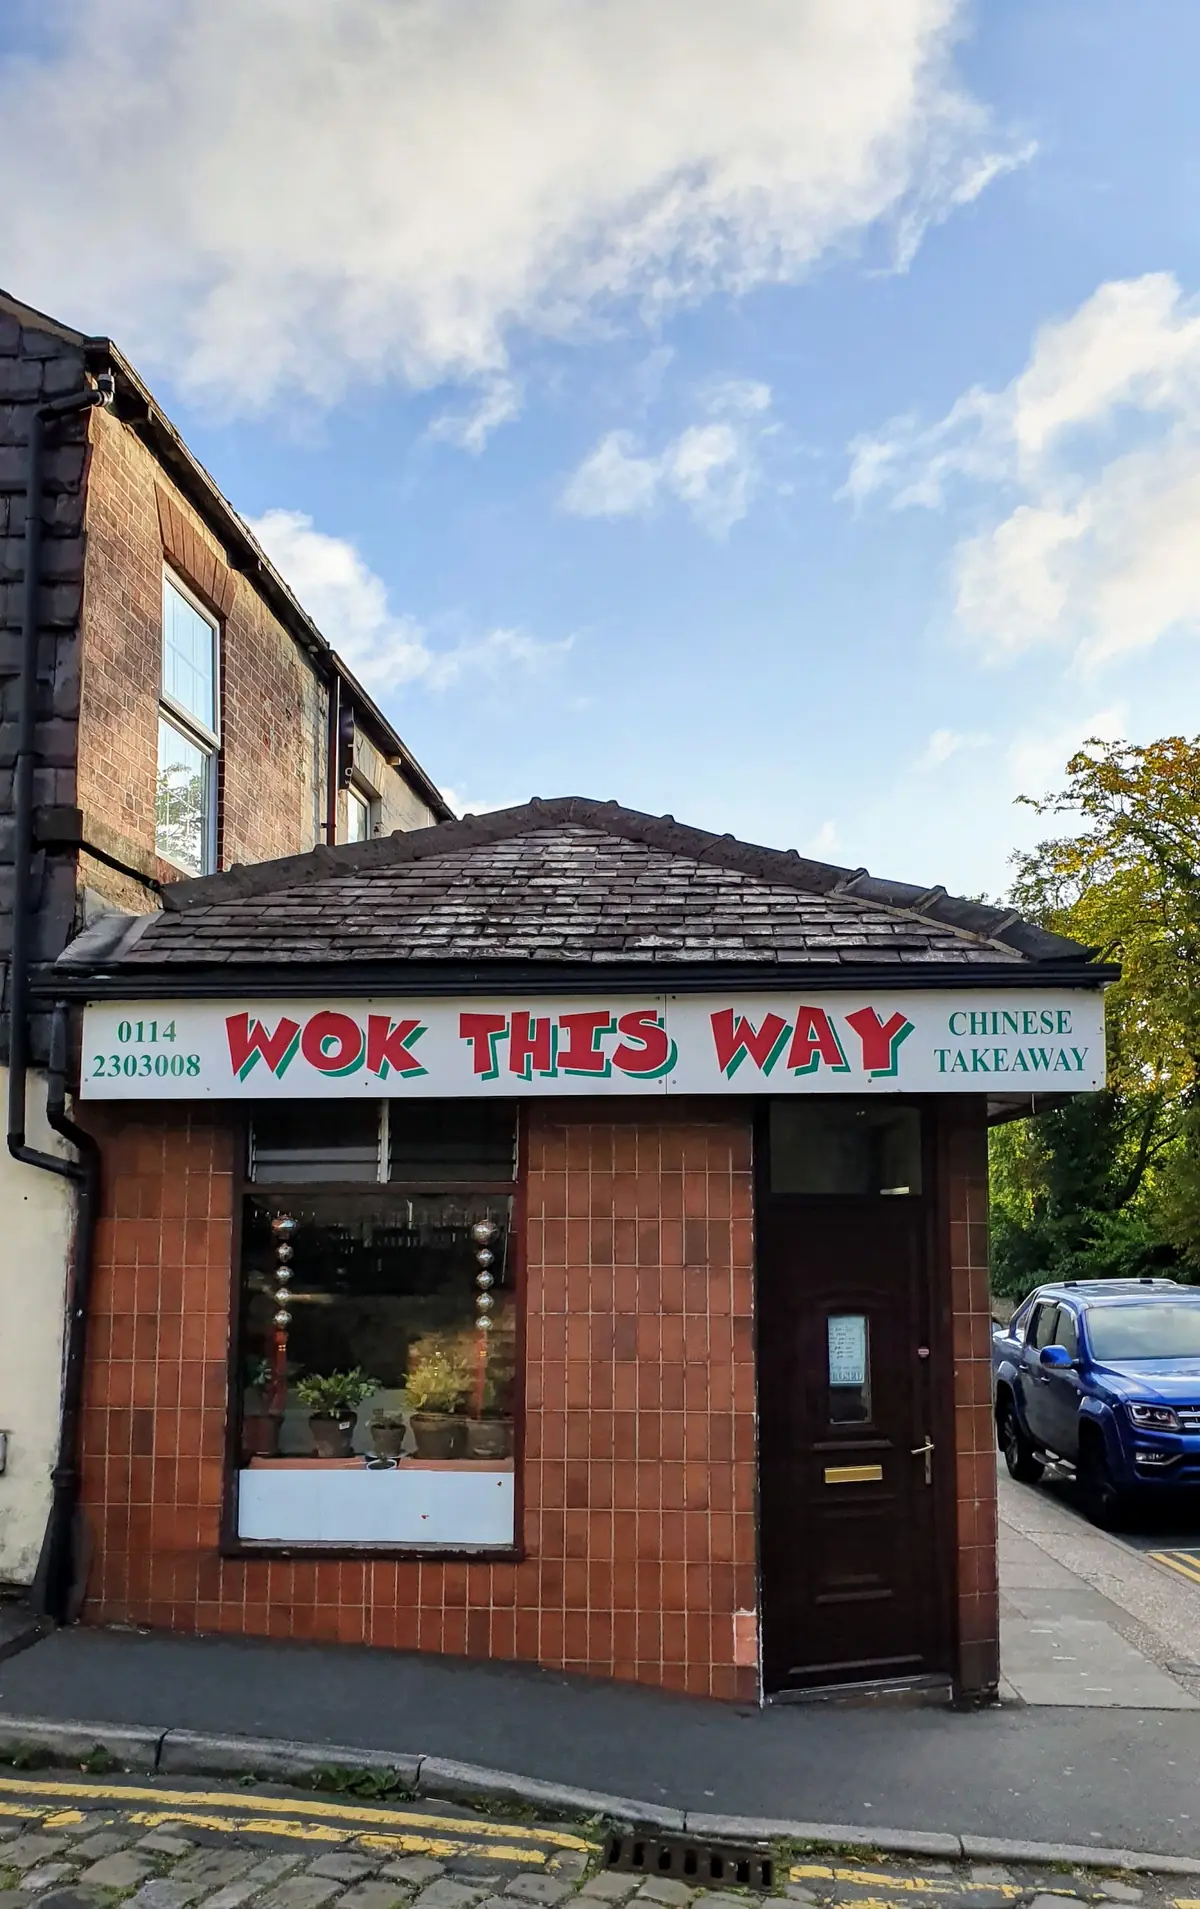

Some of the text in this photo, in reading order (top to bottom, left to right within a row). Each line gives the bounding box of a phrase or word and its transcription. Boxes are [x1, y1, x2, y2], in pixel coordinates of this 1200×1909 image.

[117, 1021, 176, 1043] 0114
[948, 1010, 1071, 1036] CHINESE
[226, 1006, 915, 1081] WOK THIS WAY
[92, 1054, 201, 1078] 2303008
[934, 1047, 1088, 1073] TAKEAWAY
